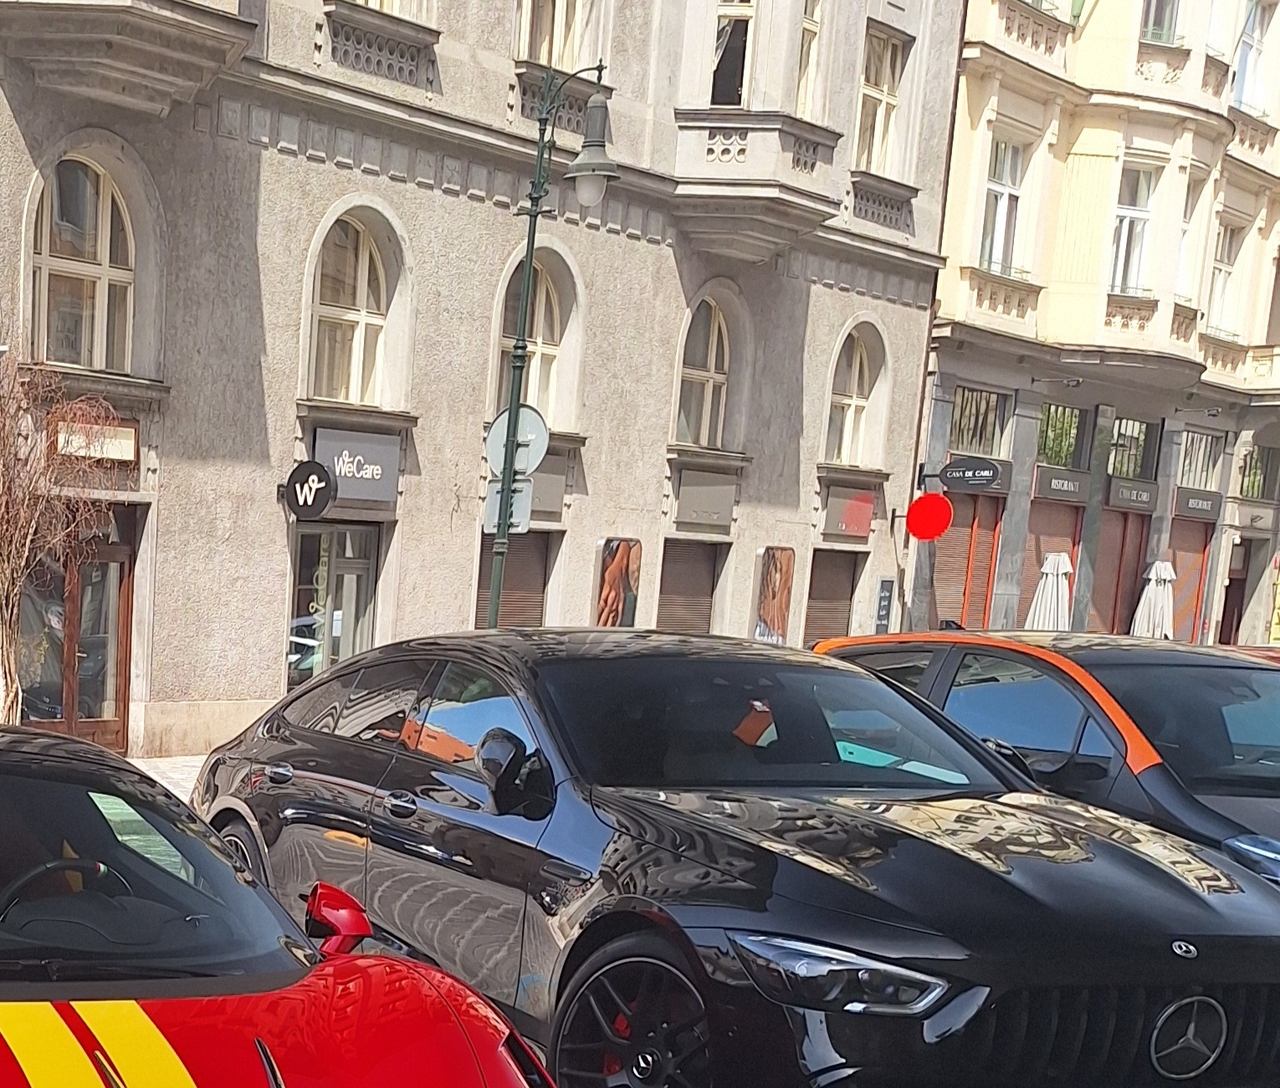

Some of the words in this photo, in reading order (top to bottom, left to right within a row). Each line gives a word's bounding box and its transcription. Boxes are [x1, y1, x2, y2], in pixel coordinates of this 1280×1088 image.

[334, 450, 382, 480] WeCare
[946, 470, 964, 478] CASA
[964, 470, 974, 478] DE
